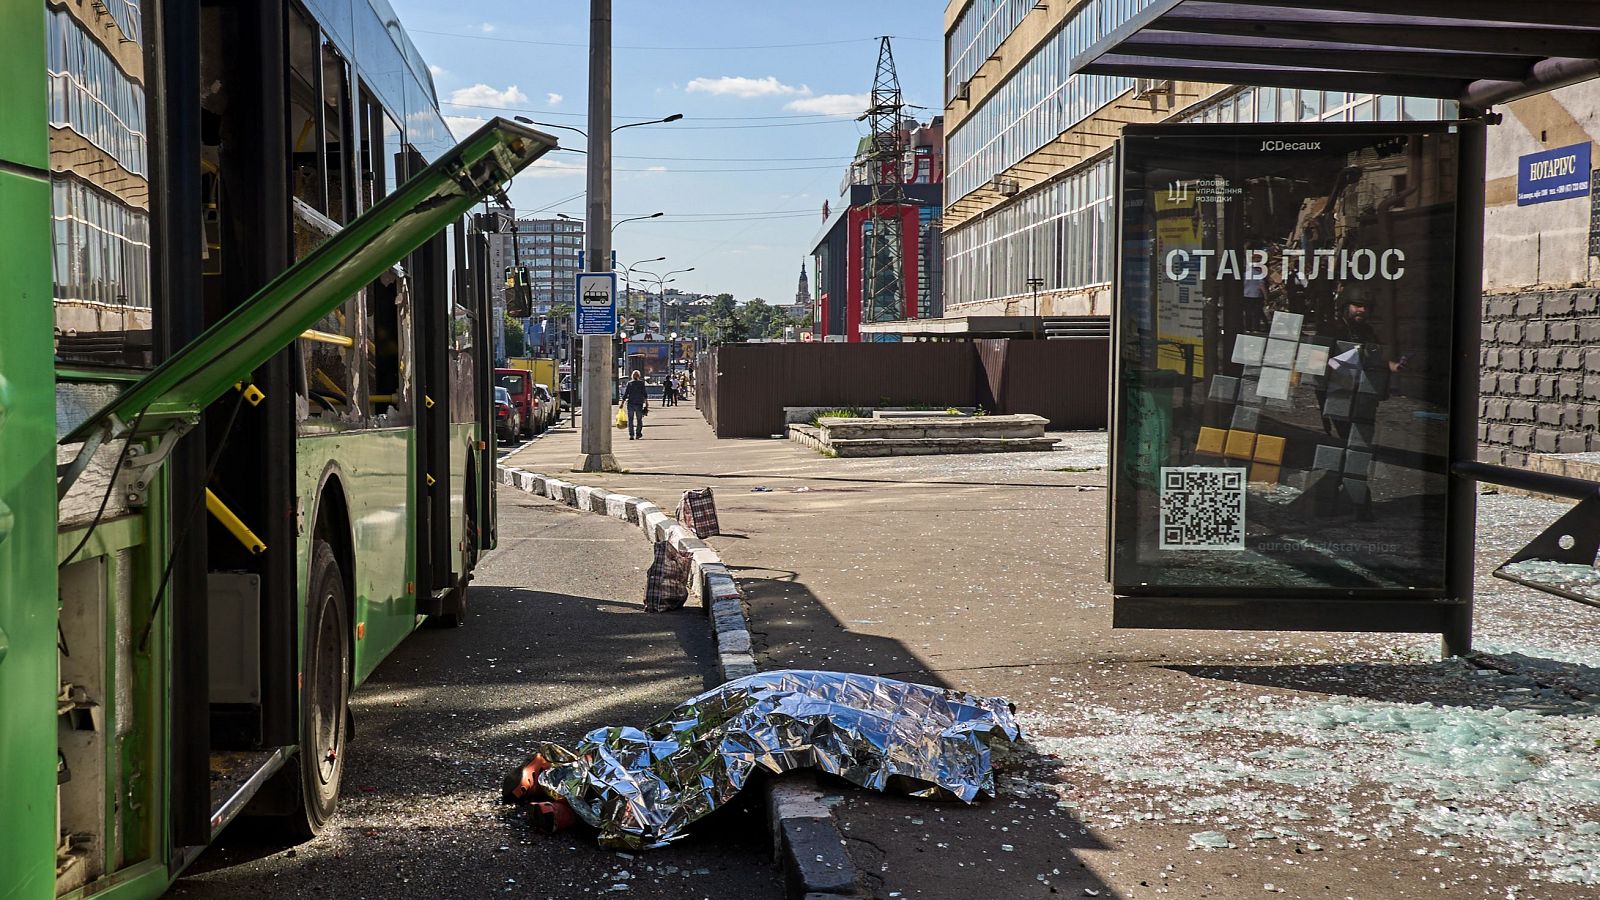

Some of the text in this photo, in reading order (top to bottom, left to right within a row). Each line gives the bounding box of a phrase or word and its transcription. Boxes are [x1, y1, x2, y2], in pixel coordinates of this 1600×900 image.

[1260, 140, 1321, 152] JCDecaux
[1530, 155, 1576, 181] НОТАРІУС
[1165, 248, 1406, 281] СТАВ ПЛЮС
